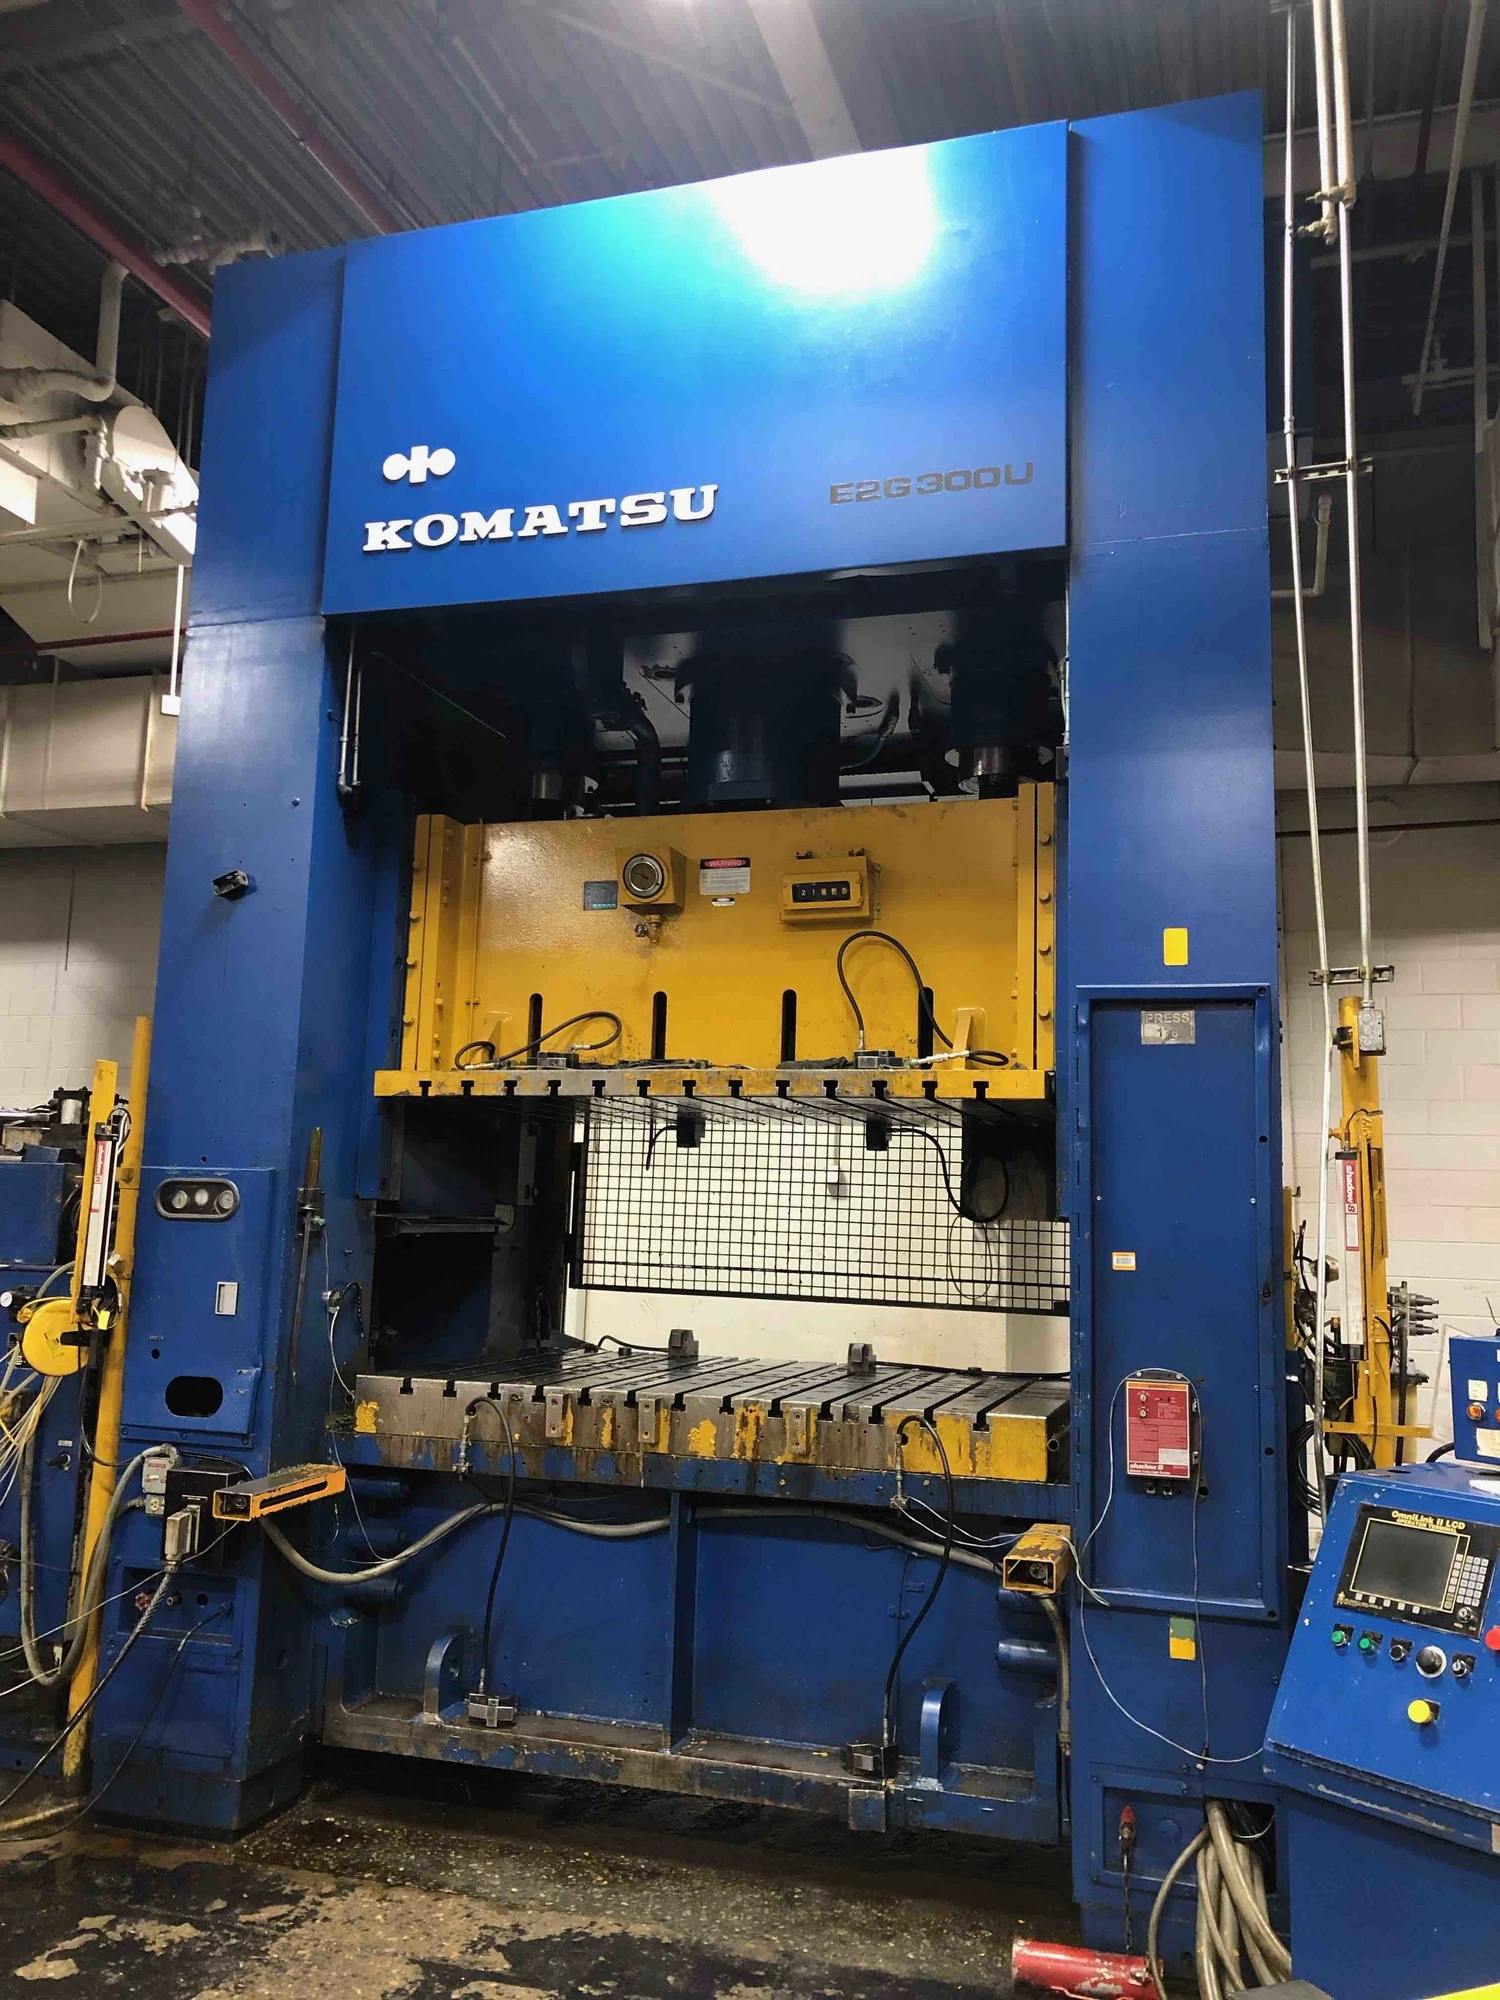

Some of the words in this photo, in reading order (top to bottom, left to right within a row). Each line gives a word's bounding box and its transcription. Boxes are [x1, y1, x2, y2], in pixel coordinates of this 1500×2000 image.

[830, 461, 1034, 505] E2G300U
[362, 483, 719, 552] KOMATSU
[709, 859, 742, 868] WARNING
[1145, 1012, 1190, 1024] PRESS
[1346, 1165, 1355, 1204] shadow
[1347, 1204, 1355, 1212] 8
[1391, 1510, 1434, 1525] OmniLink
[1445, 1520, 1466, 1530] LCD
